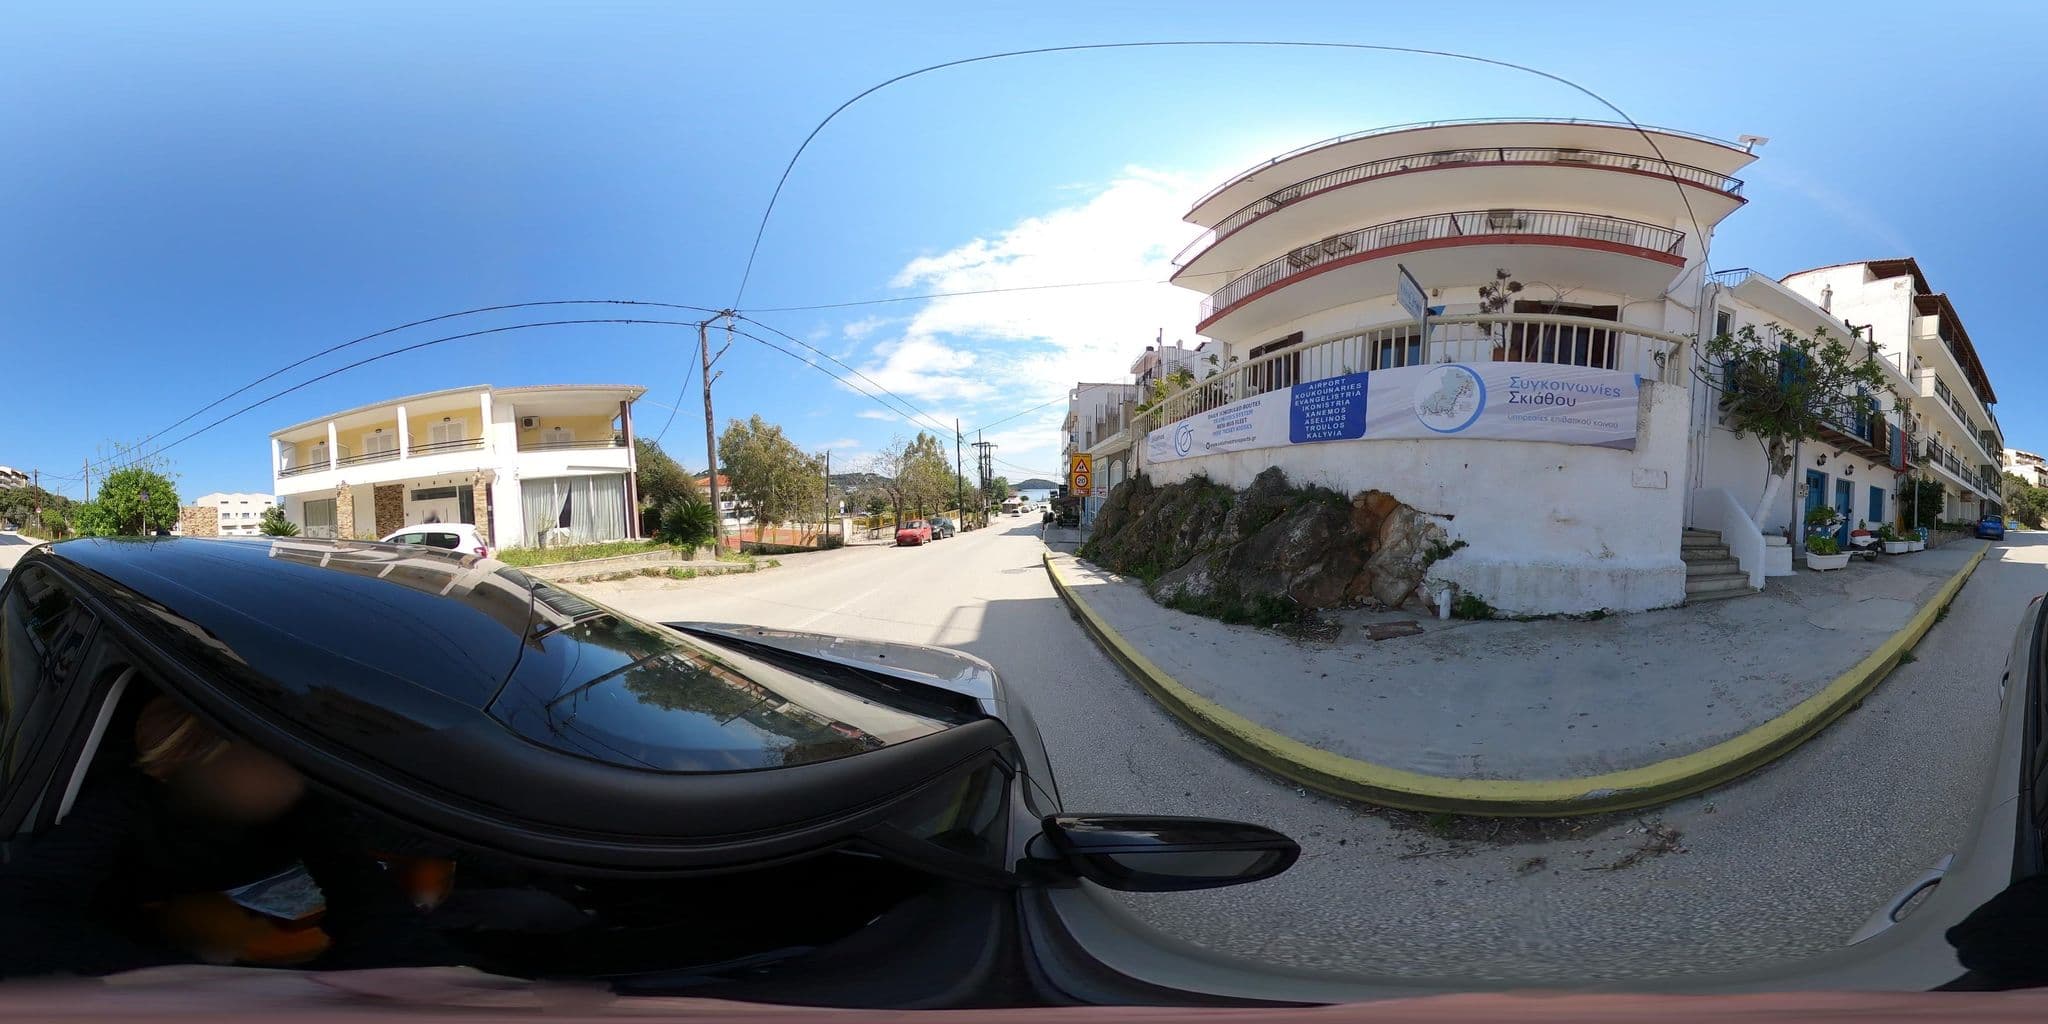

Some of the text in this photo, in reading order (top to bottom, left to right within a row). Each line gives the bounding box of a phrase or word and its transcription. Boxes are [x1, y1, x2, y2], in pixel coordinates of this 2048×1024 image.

[1309, 378, 1346, 390] AIRPORT
[1509, 376, 1621, 398] Συγκοινωνίες
[1295, 382, 1362, 399] KOUKOUNARIES
[1295, 390, 1361, 407] EVANGELISTRIA
[1508, 390, 1576, 407] Σκιάθου
[1302, 399, 1350, 411] IKONISTRIA
[1306, 407, 1346, 418] XANEMOS
[1304, 414, 1346, 425] ASELINOS
[1305, 422, 1345, 432] TROULOS
[1306, 430, 1342, 439] KALYVIA
